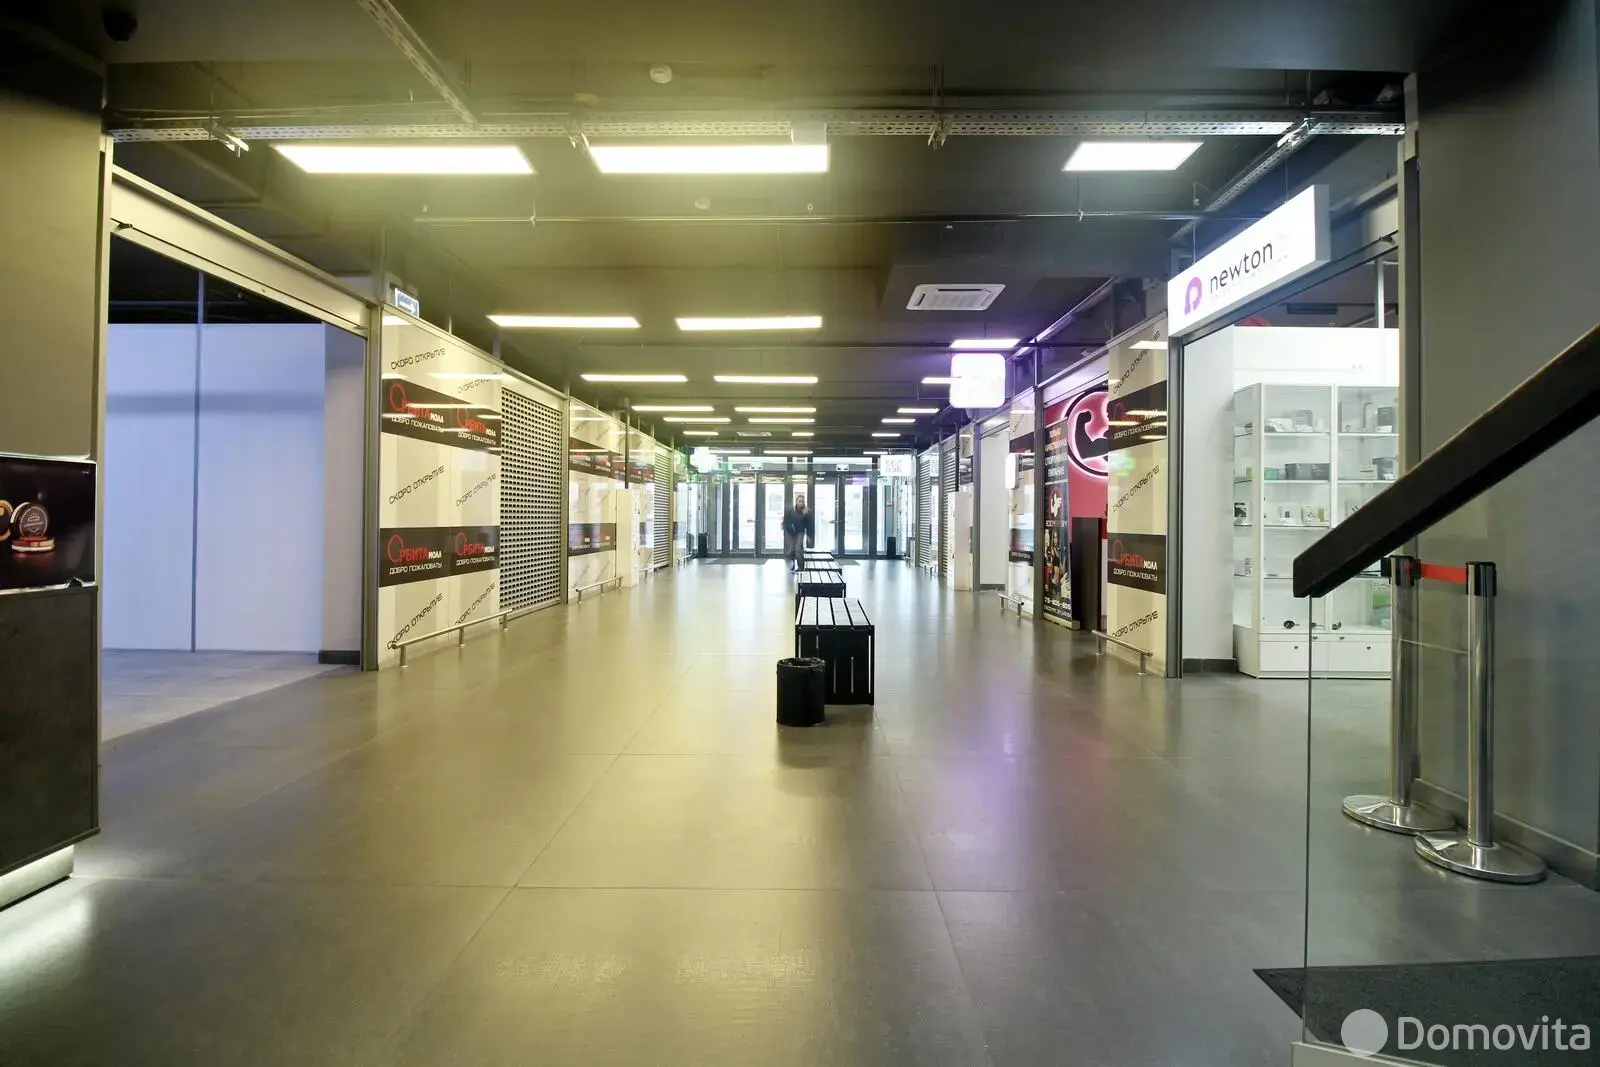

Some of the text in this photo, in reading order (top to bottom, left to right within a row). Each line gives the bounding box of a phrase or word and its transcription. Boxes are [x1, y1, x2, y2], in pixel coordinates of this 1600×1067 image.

[1210, 242, 1273, 294] newton
[391, 348, 446, 370] СКОРО ОТКРЫТИЕ
[388, 465, 444, 504] СКОРО ОТКРЫТИЕ
[1112, 465, 1160, 512] СКОРО ОТКРЫТИЕ
[455, 491, 472, 506] СКОРО
[389, 565, 408, 575] ДОБРО
[456, 558, 470, 566] ДОБРО
[1113, 568, 1126, 577] ДОБРО
[472, 582, 495, 610] ОТКРЫТИЕ
[387, 593, 443, 649] СКОРО ОТКРЫТИЕ
[1128, 610, 1159, 632] ОТКРЫТИЕ
